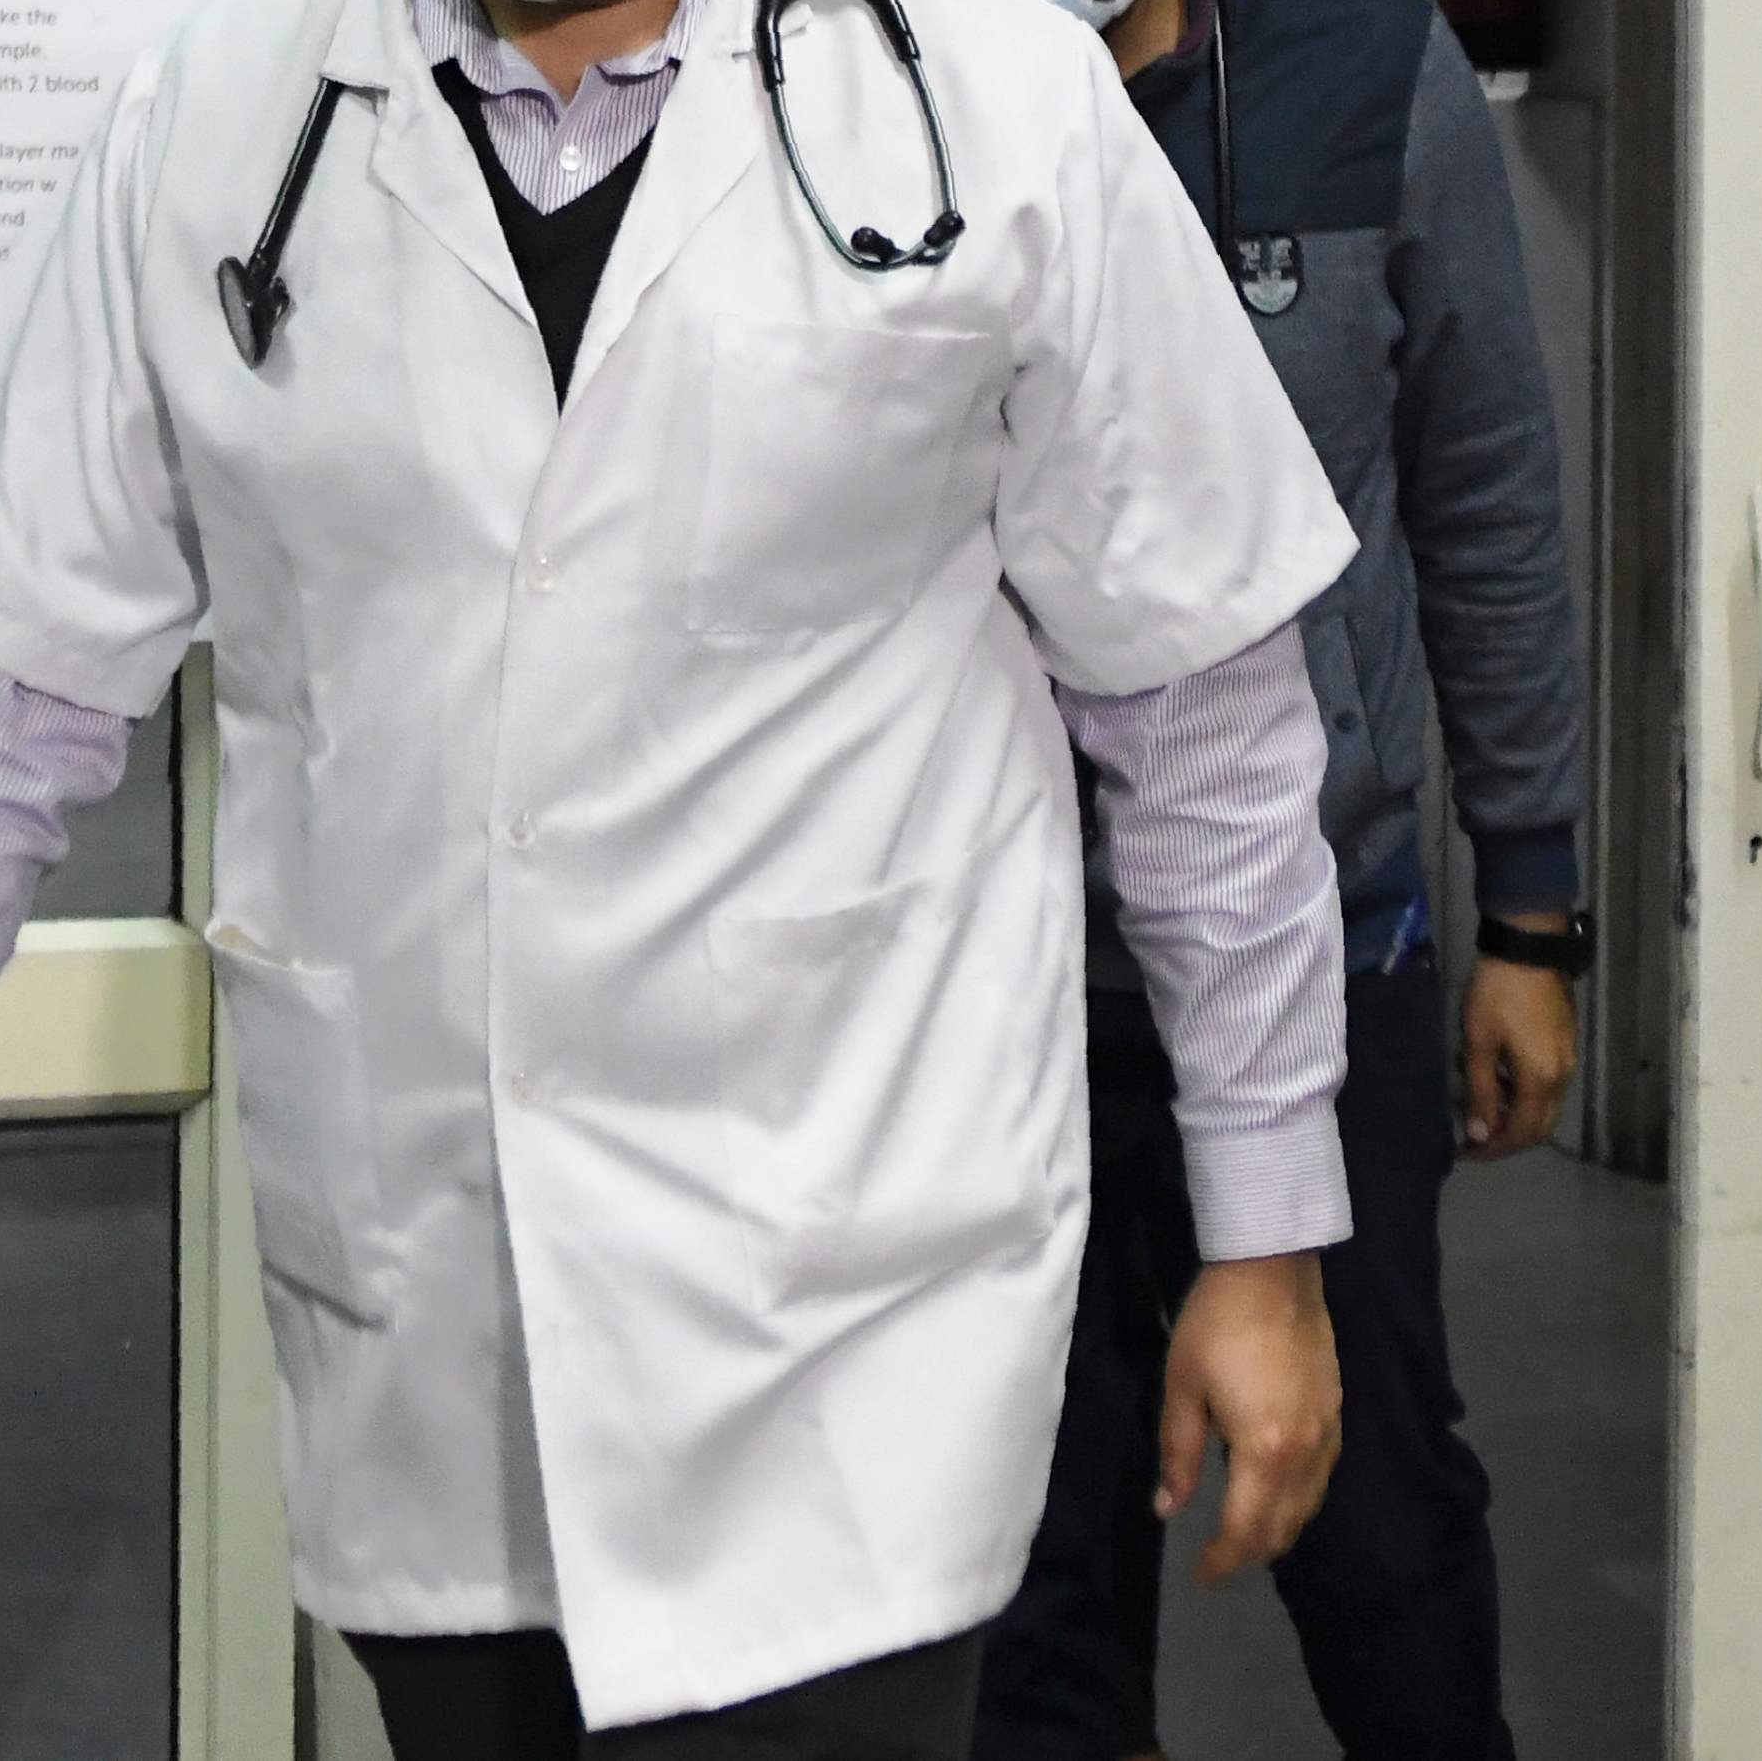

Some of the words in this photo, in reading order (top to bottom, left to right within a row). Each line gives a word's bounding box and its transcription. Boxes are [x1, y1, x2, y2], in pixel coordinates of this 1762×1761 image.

[26, 6, 57, 25] the
[28, 74, 39, 92] 2
[45, 74, 100, 92] blood
